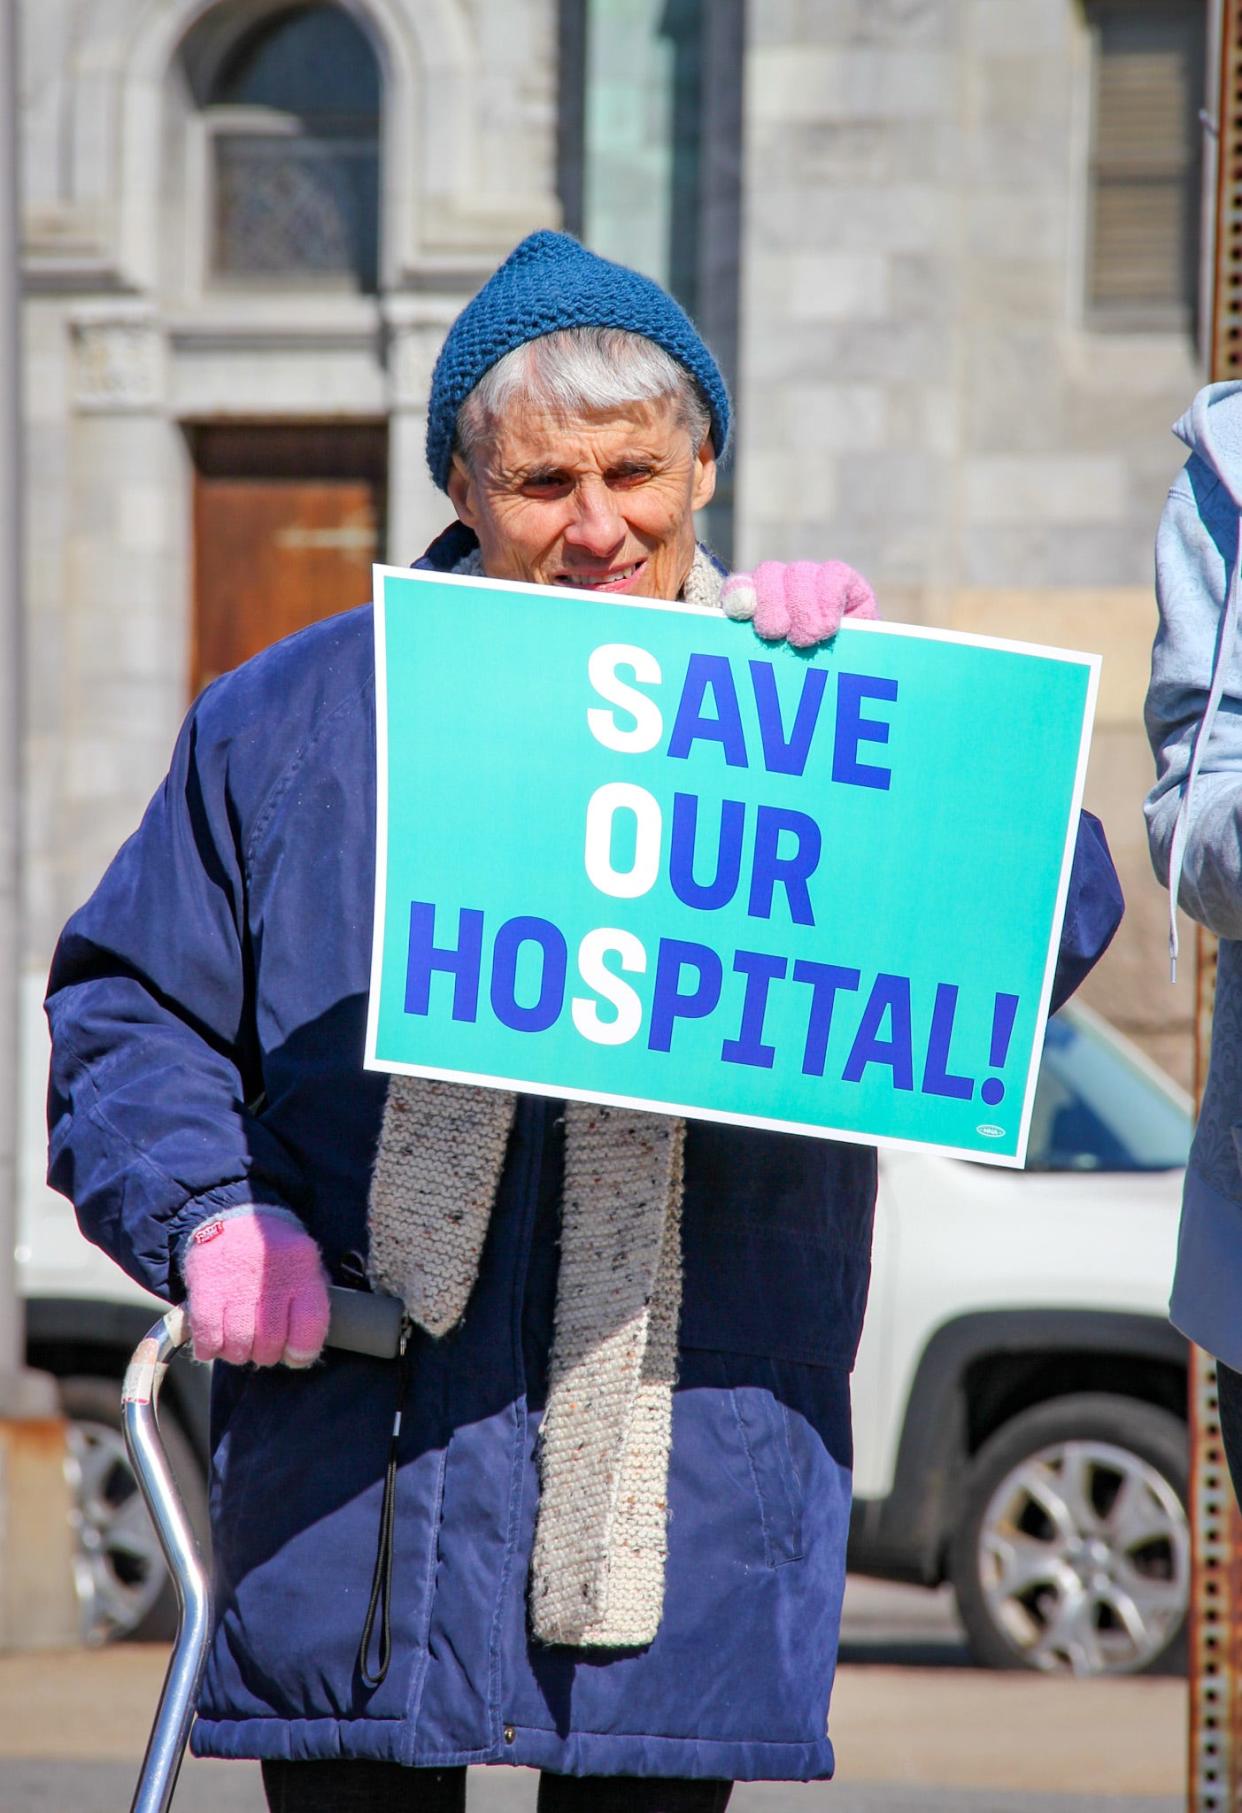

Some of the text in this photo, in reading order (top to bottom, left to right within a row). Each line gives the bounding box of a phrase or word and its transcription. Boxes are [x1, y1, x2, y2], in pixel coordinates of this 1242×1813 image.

[587, 643, 898, 790] SAVE
[584, 782, 822, 926] OUR
[403, 900, 1019, 1106] HOSPITAL!
